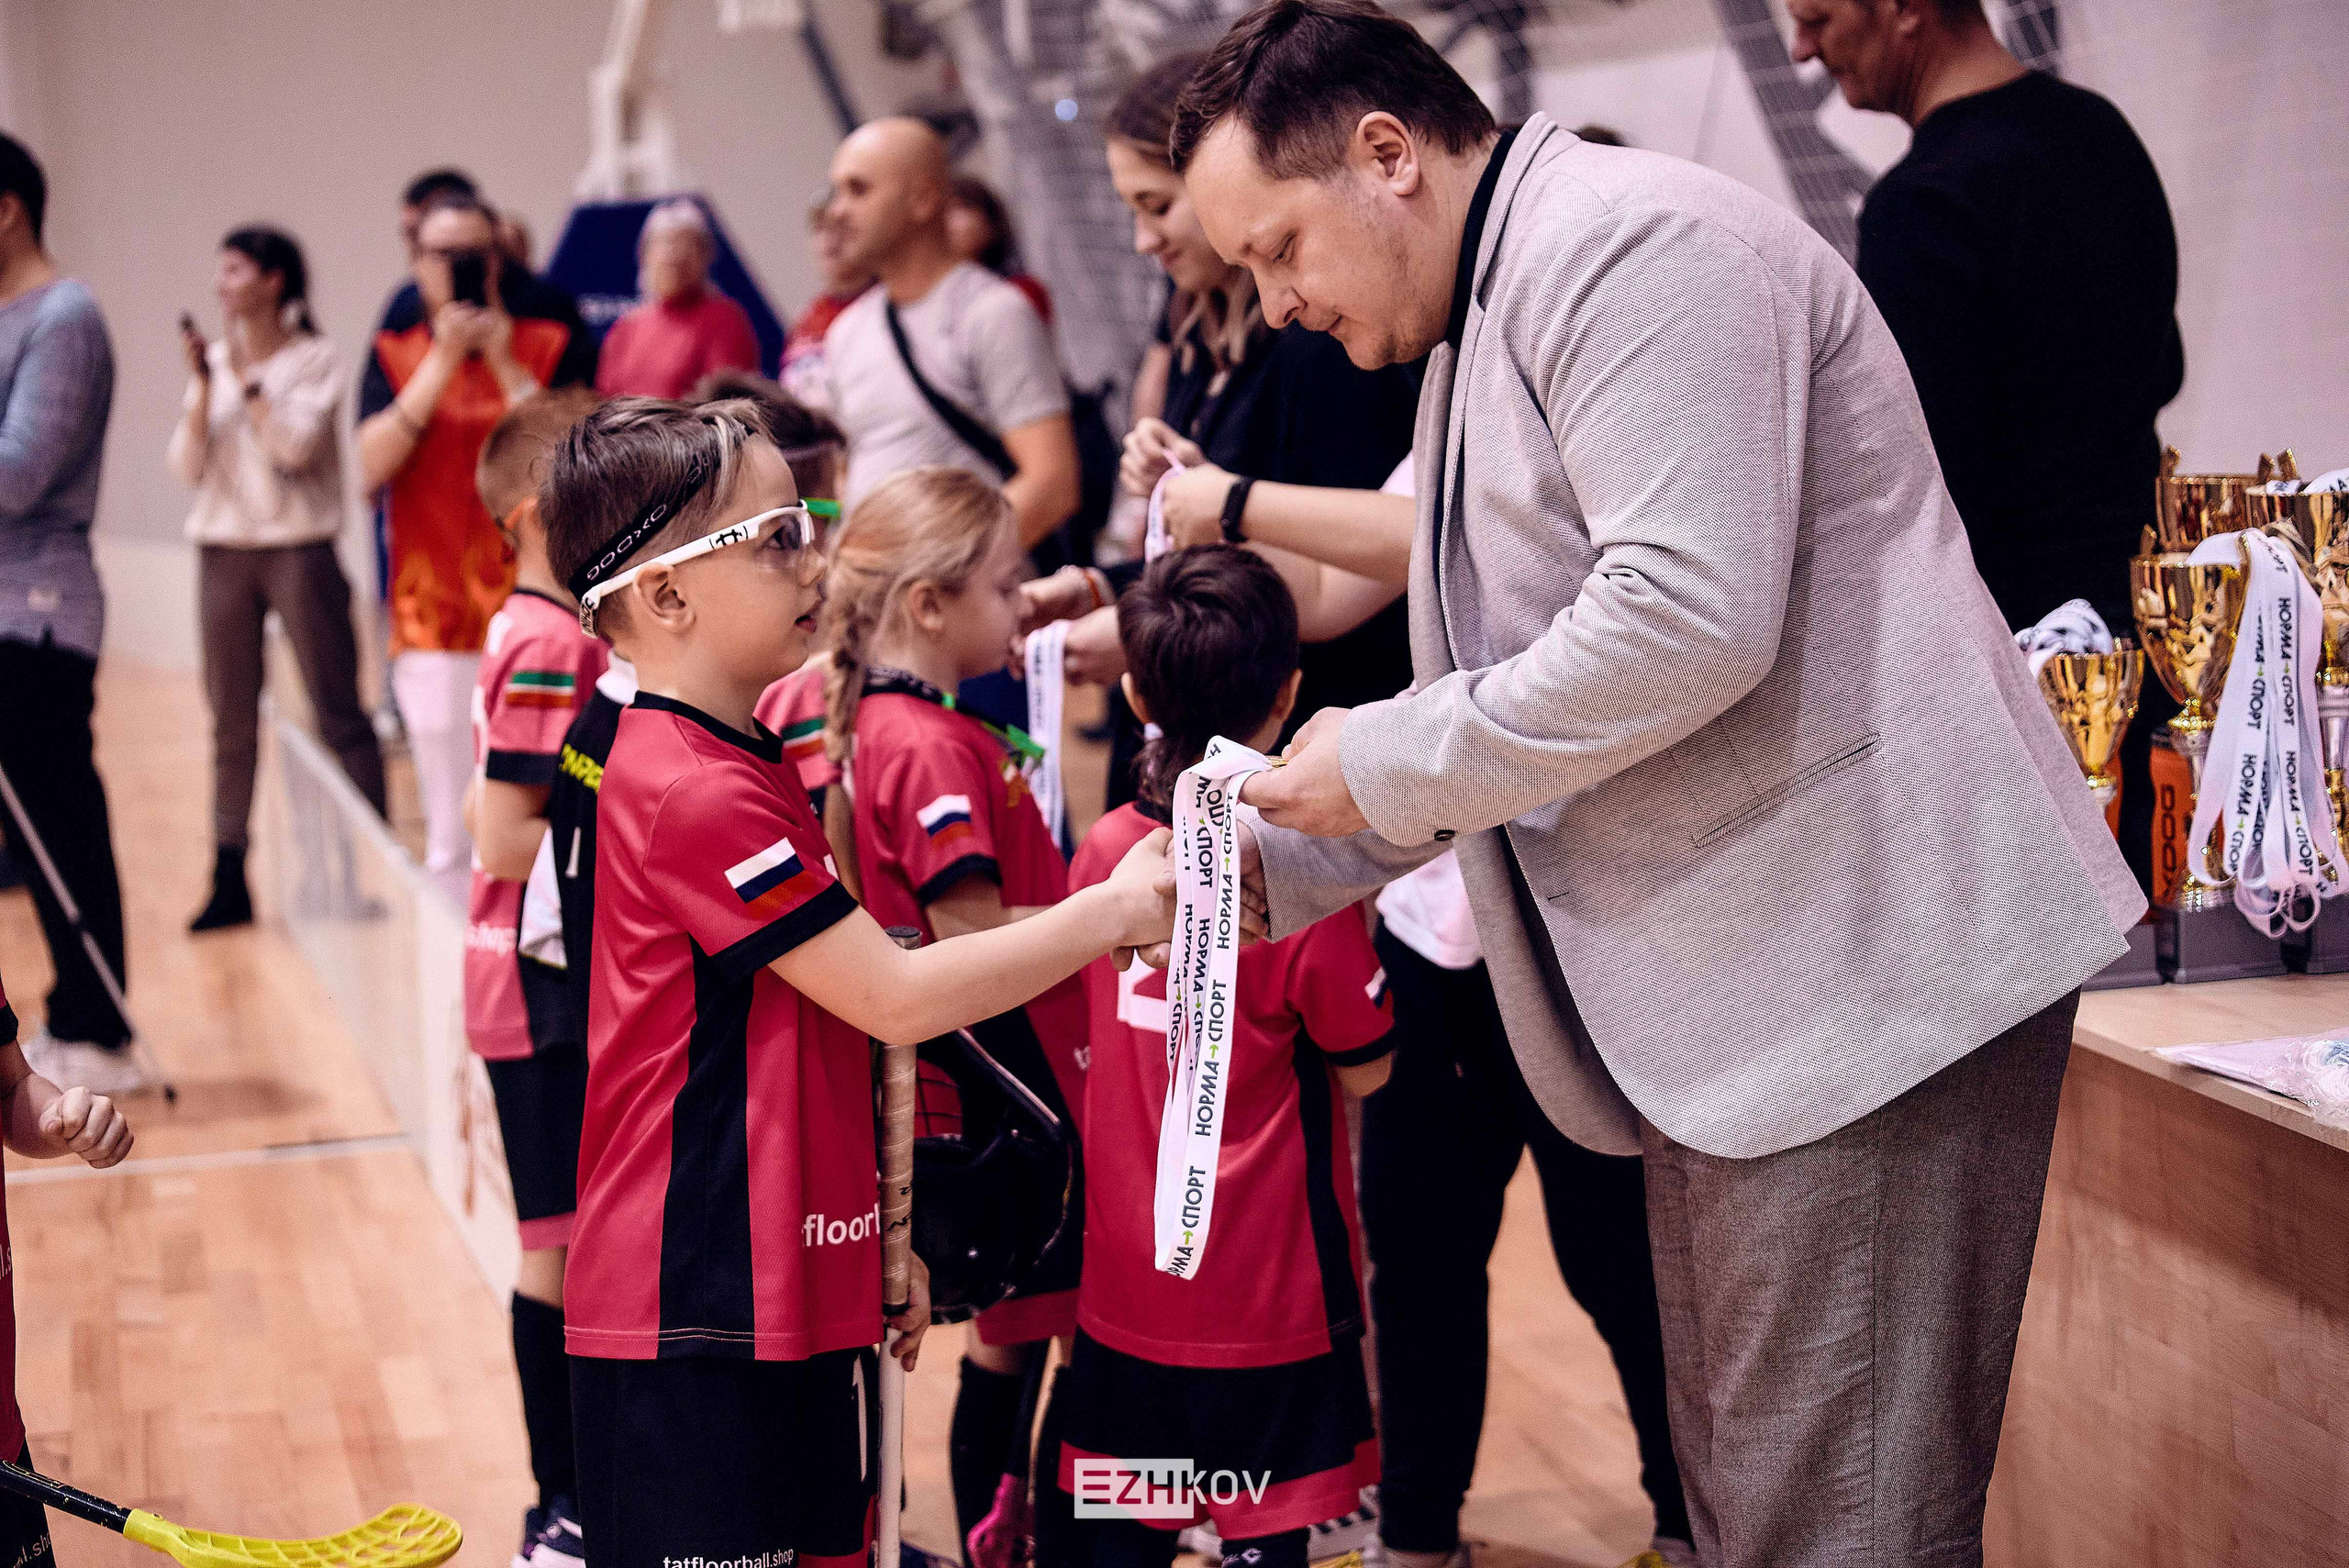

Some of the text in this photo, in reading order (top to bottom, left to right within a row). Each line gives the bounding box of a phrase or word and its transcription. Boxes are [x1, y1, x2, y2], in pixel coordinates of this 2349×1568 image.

[587, 505, 666, 581] OXDOG
[2248, 679, 2266, 729] СПОРТ
[2282, 675, 2295, 726] СПОРТ
[2229, 753, 2257, 873] НОРМА СПОР
[1196, 826, 1213, 888] СПОРТ
[2297, 828, 2313, 875] СПОРТ
[1193, 918, 1210, 993] НОРМА
[1166, 792, 1234, 1277] РМА СПОРТ НОРМА СПОРТ НОРМА СПОРТ
[1170, 1002, 1183, 1062] СПОРТ
